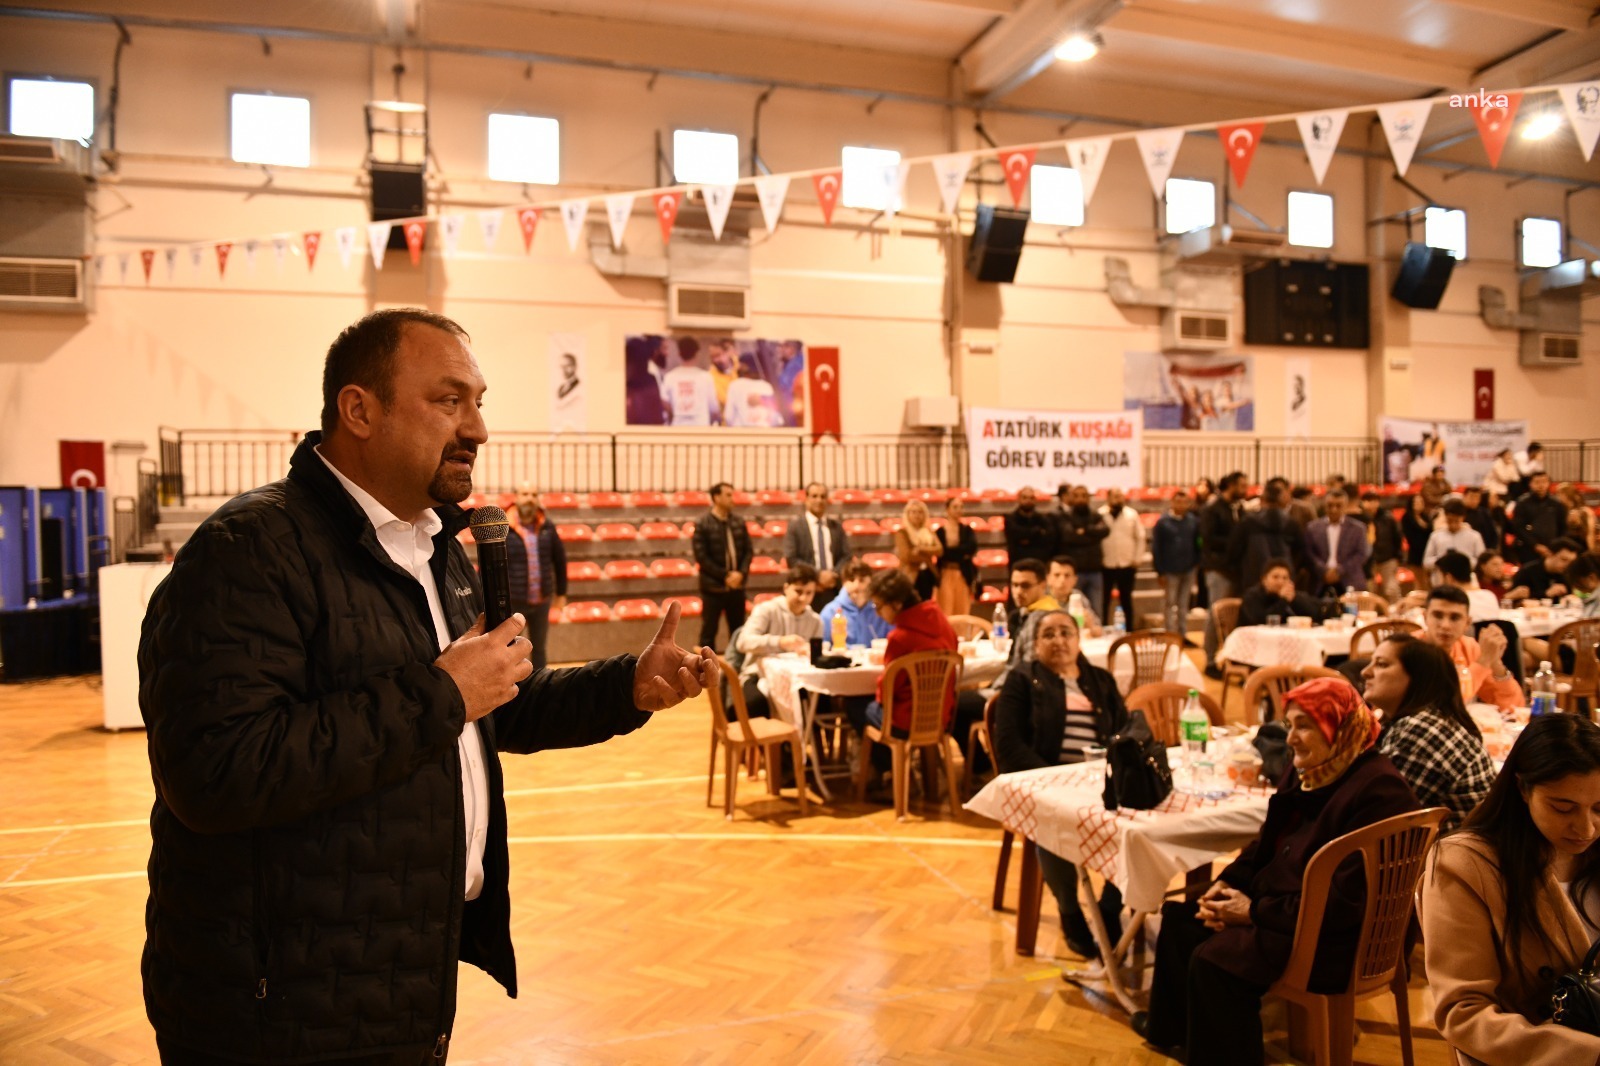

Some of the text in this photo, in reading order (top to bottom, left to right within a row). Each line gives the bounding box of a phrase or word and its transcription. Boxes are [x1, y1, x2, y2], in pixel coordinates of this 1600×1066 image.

[983, 416, 1133, 444] ATATÜRK KUŞAĞI
[986, 446, 1130, 473] GÖREV BAŞINDA
